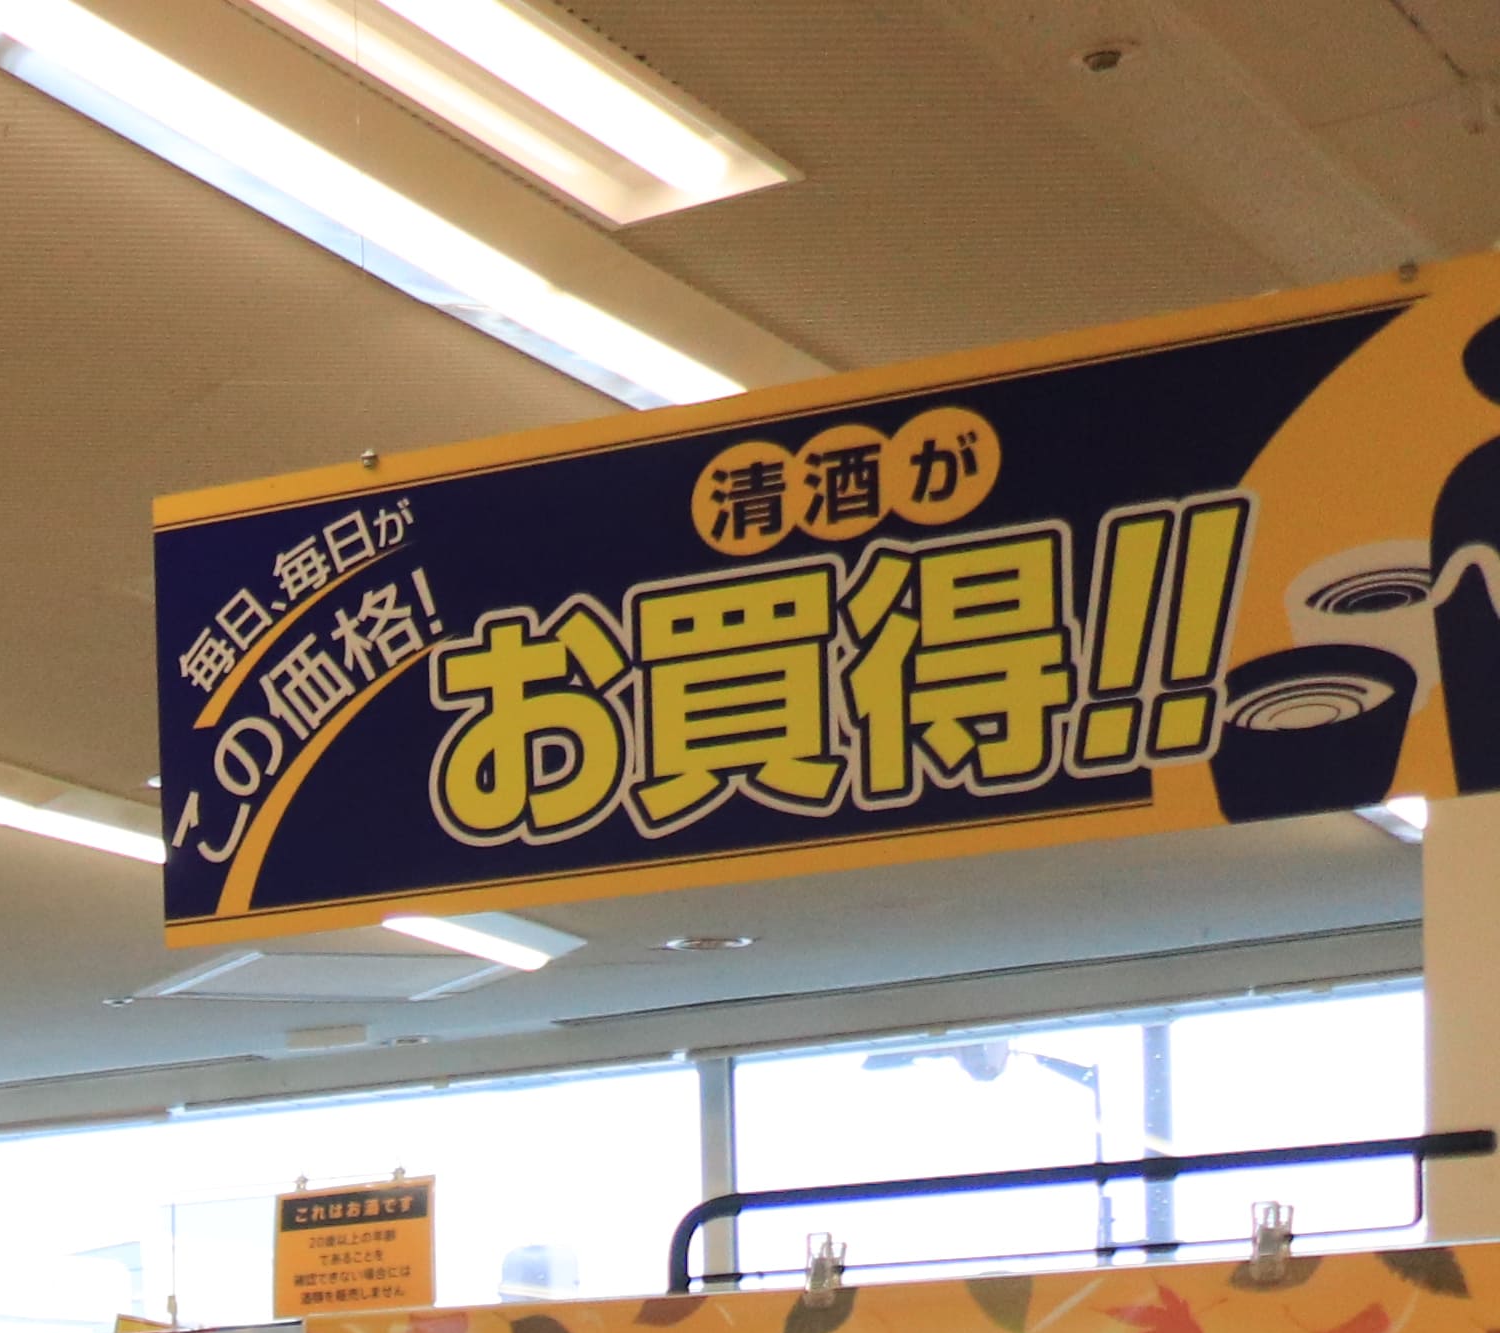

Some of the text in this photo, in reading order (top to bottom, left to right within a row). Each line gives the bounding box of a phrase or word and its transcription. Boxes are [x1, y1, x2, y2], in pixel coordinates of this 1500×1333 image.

[708, 429, 983, 542] 清酒が
[177, 499, 414, 691] 毎日、毎日が
[295, 1196, 412, 1223] これはお酒です
